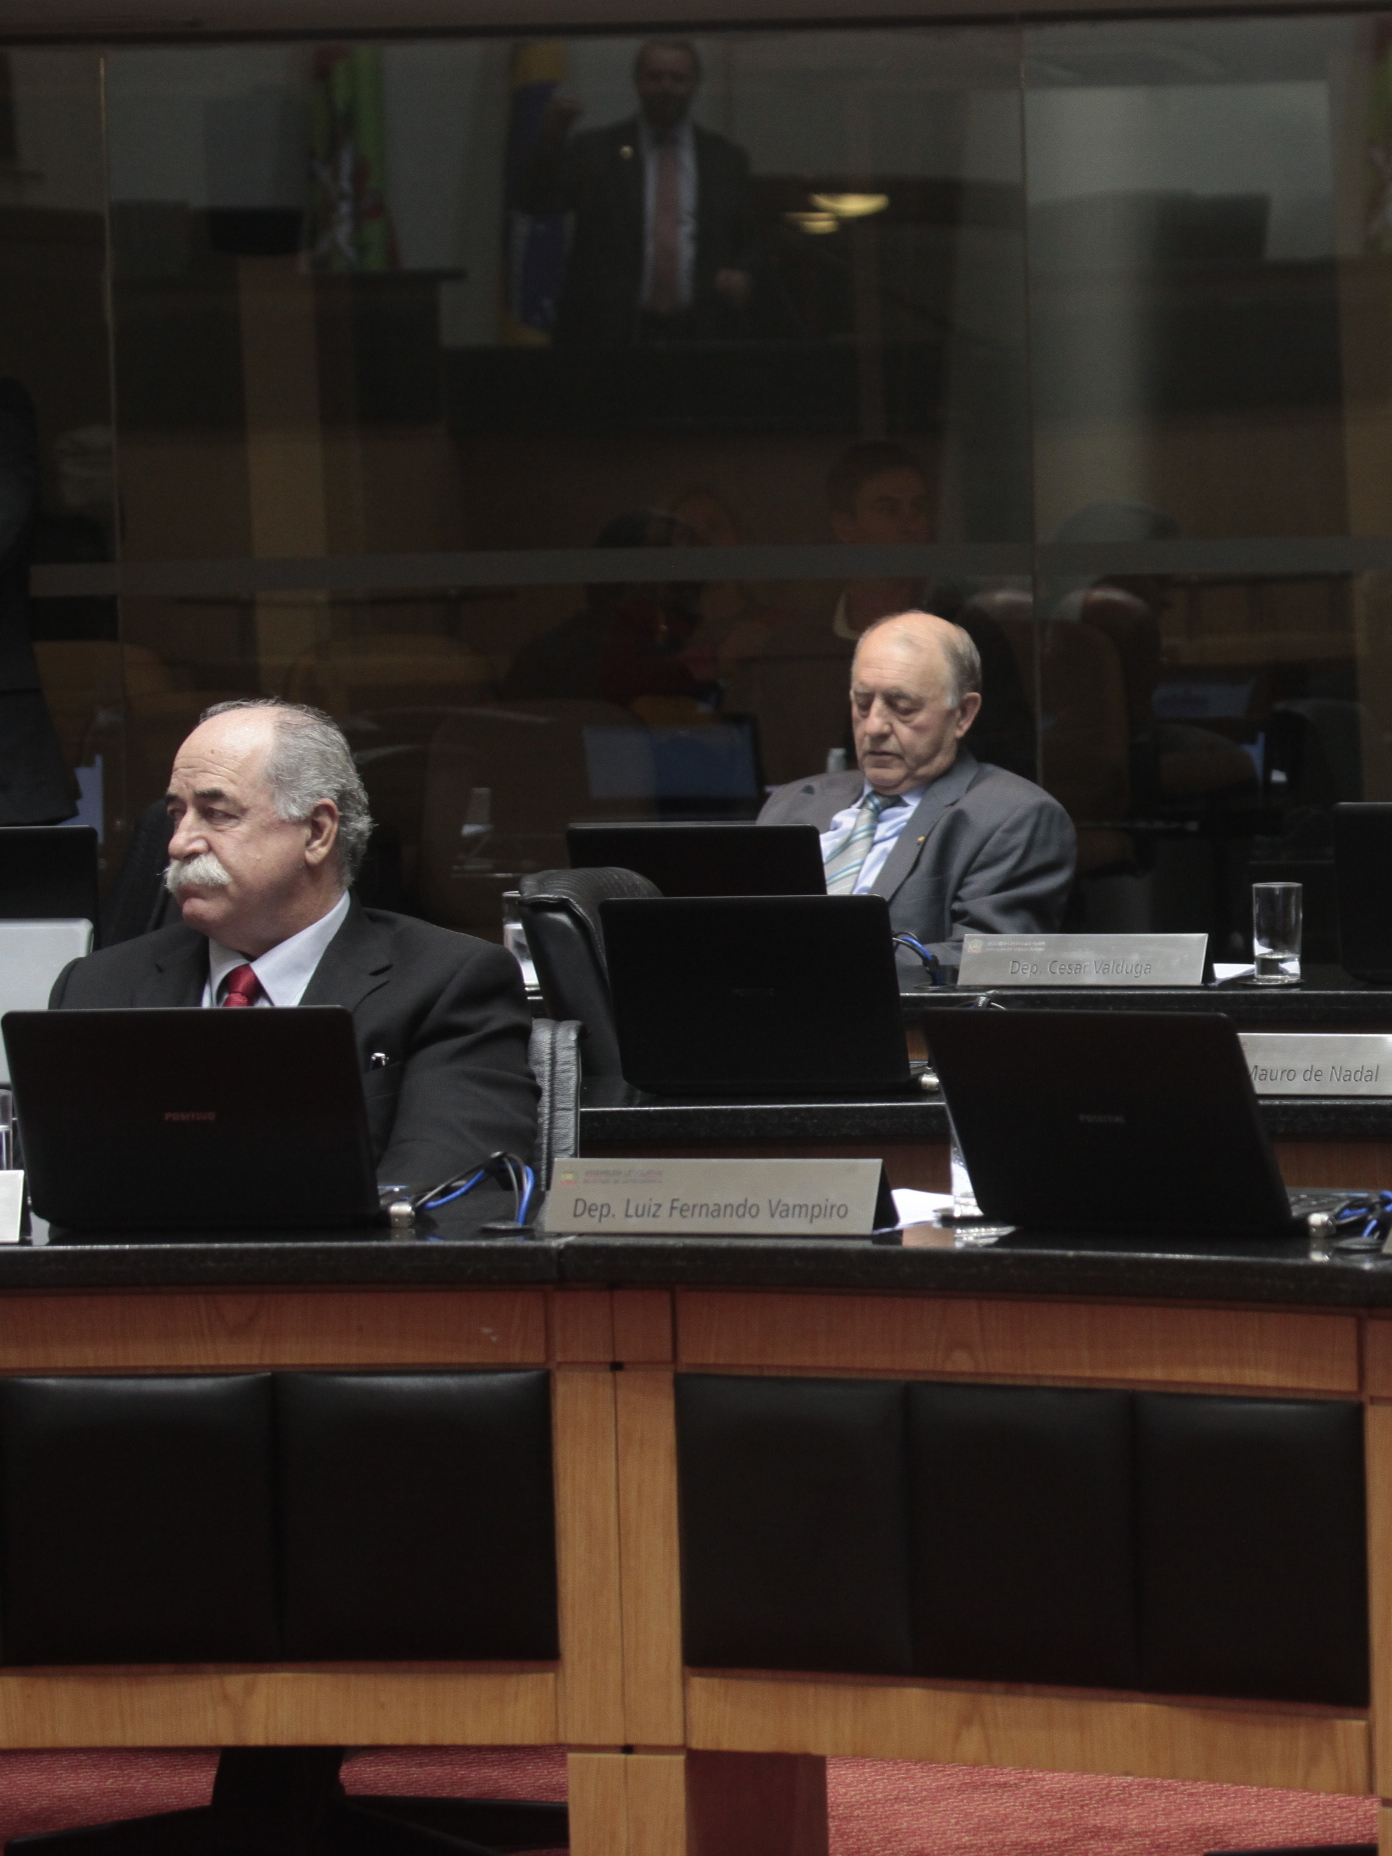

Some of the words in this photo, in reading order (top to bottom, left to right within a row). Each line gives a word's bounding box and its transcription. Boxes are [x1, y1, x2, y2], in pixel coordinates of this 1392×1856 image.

[1009, 960, 1042, 978] Dep.
[1048, 960, 1089, 975] Cesar
[1093, 960, 1152, 978] Valduga
[1302, 1065, 1323, 1082] de
[1329, 1065, 1380, 1082] Nadal
[572, 1198, 616, 1223] Dep.
[624, 1198, 662, 1218] Luiz
[668, 1198, 760, 1219] Fernando
[768, 1198, 849, 1223] Vampiro
